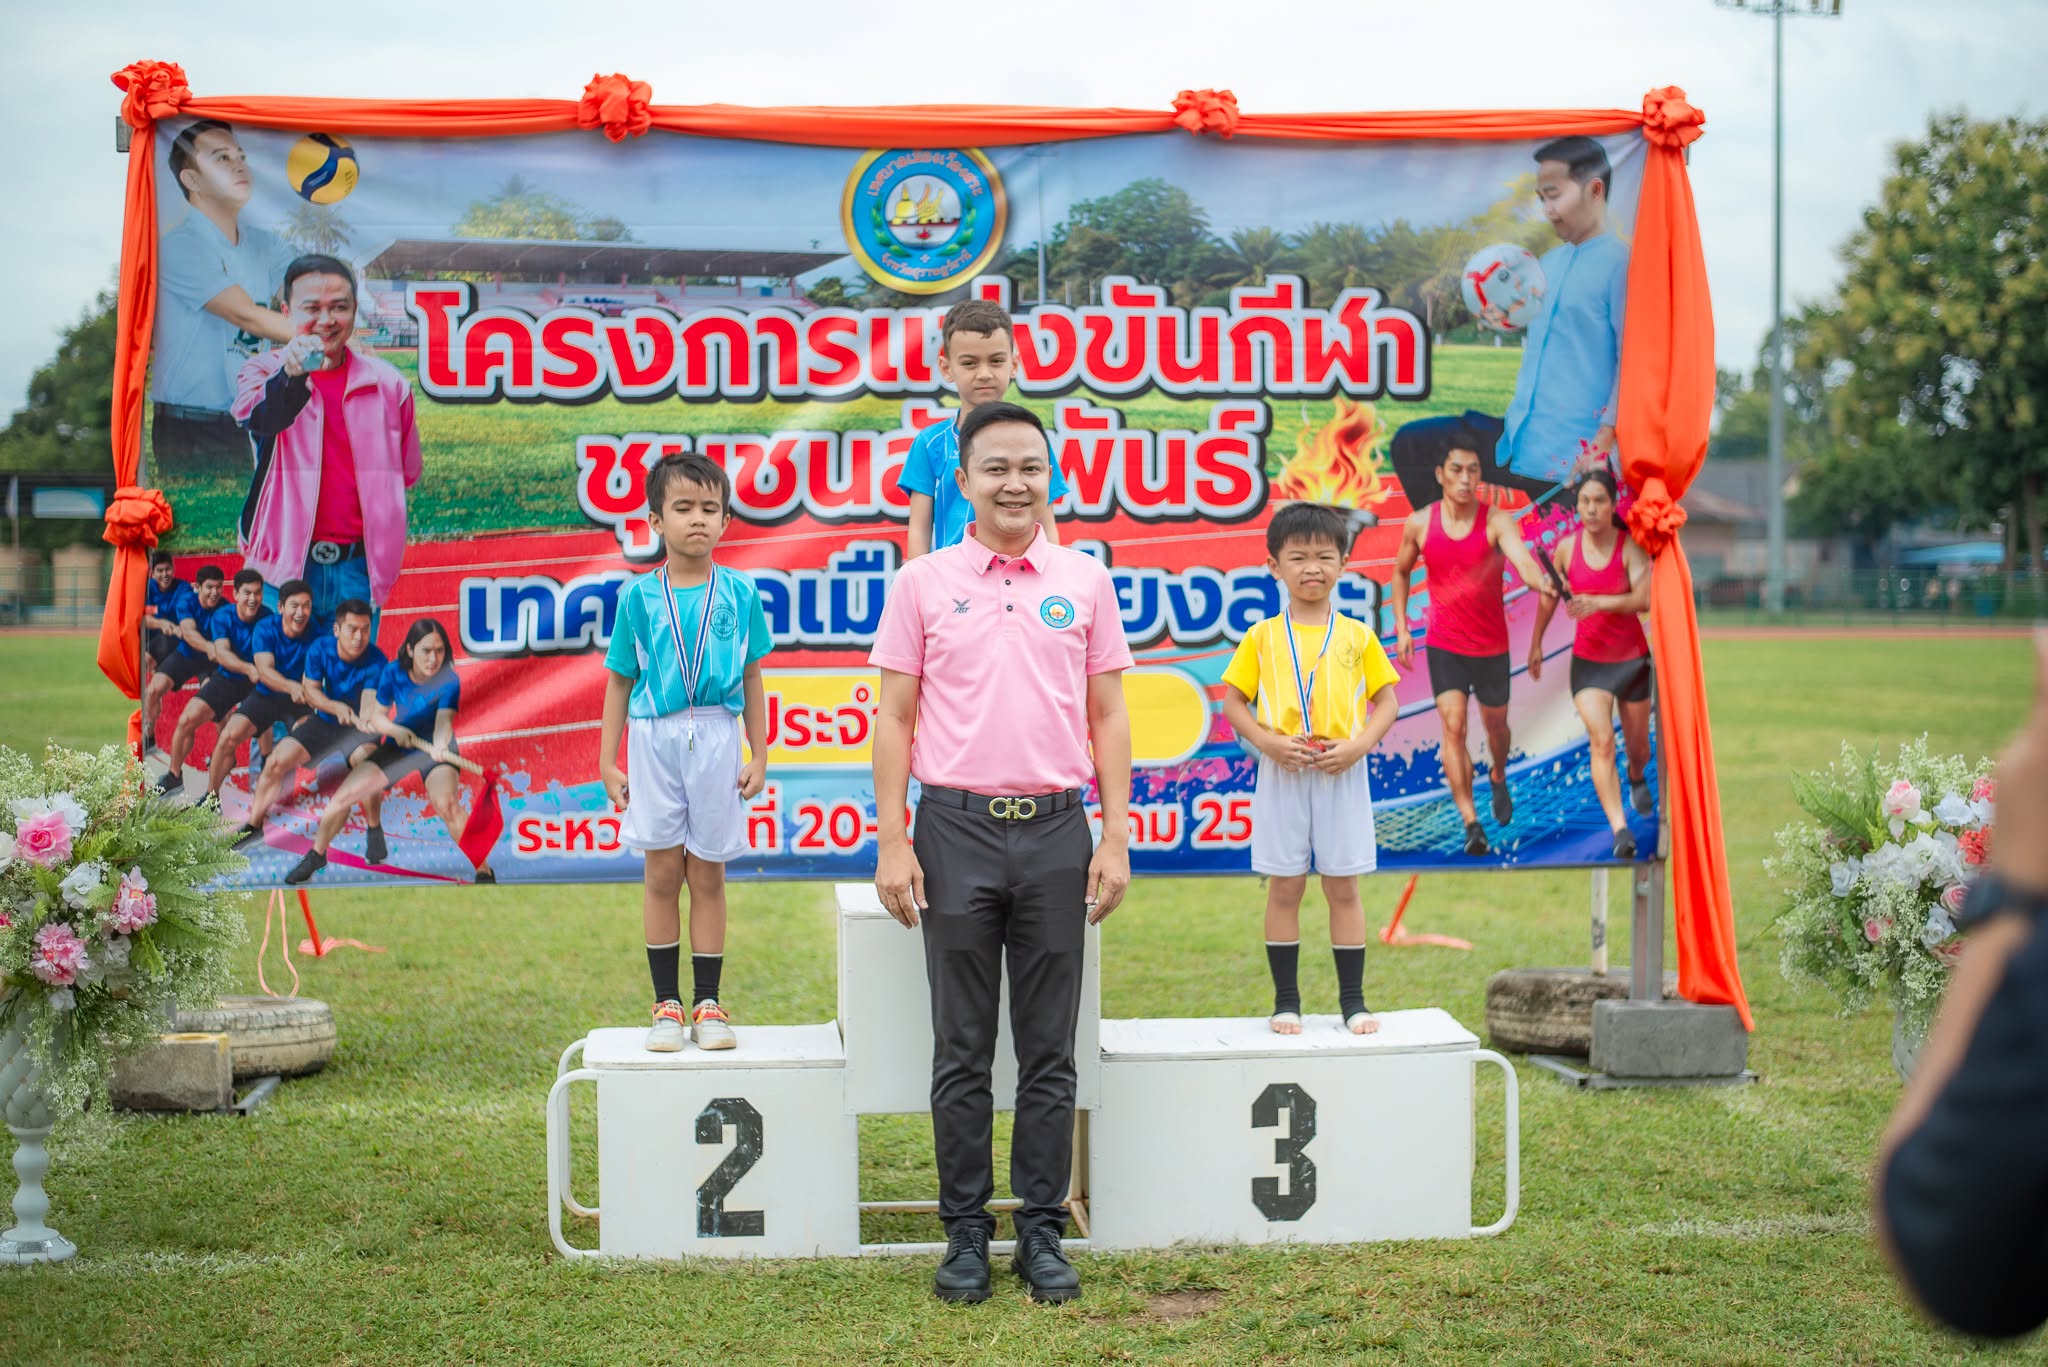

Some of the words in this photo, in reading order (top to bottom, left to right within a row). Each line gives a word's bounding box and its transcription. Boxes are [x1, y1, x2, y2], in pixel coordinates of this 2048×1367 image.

[413, 282, 1418, 388] โครงการแ่งขันกีฬา
[1199, 799, 1252, 842] 25
[695, 1096, 765, 1238] 2
[1250, 1082, 1318, 1222] 3
